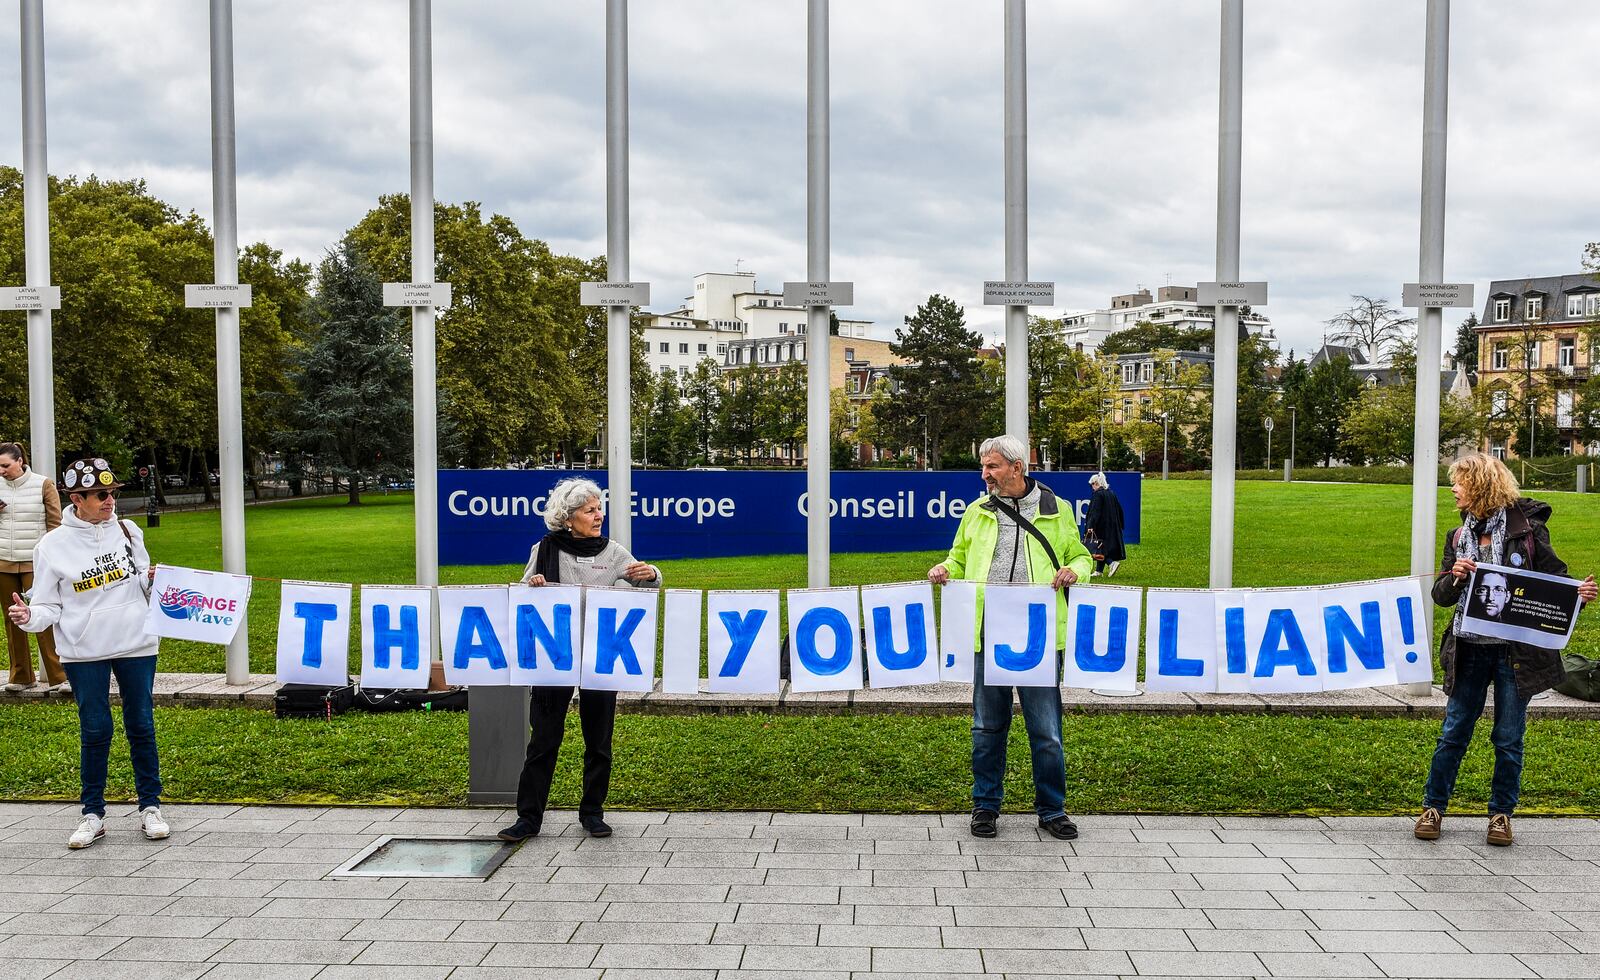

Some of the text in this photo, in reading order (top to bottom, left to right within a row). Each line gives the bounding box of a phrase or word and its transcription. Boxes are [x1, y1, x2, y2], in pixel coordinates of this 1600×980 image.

[448, 489, 552, 516] Counc
[926, 491, 967, 518] de
[93, 552, 114, 565] FREE
[72, 579, 94, 592] FREE
[107, 570, 124, 583] ALL
[80, 561, 119, 580] ASSANGE
[166, 584, 181, 593] free
[160, 591, 237, 612] ASSANGE
[186, 604, 233, 626] Wave
[294, 602, 647, 675] THANK
[993, 596, 1418, 677] JULIAN!
